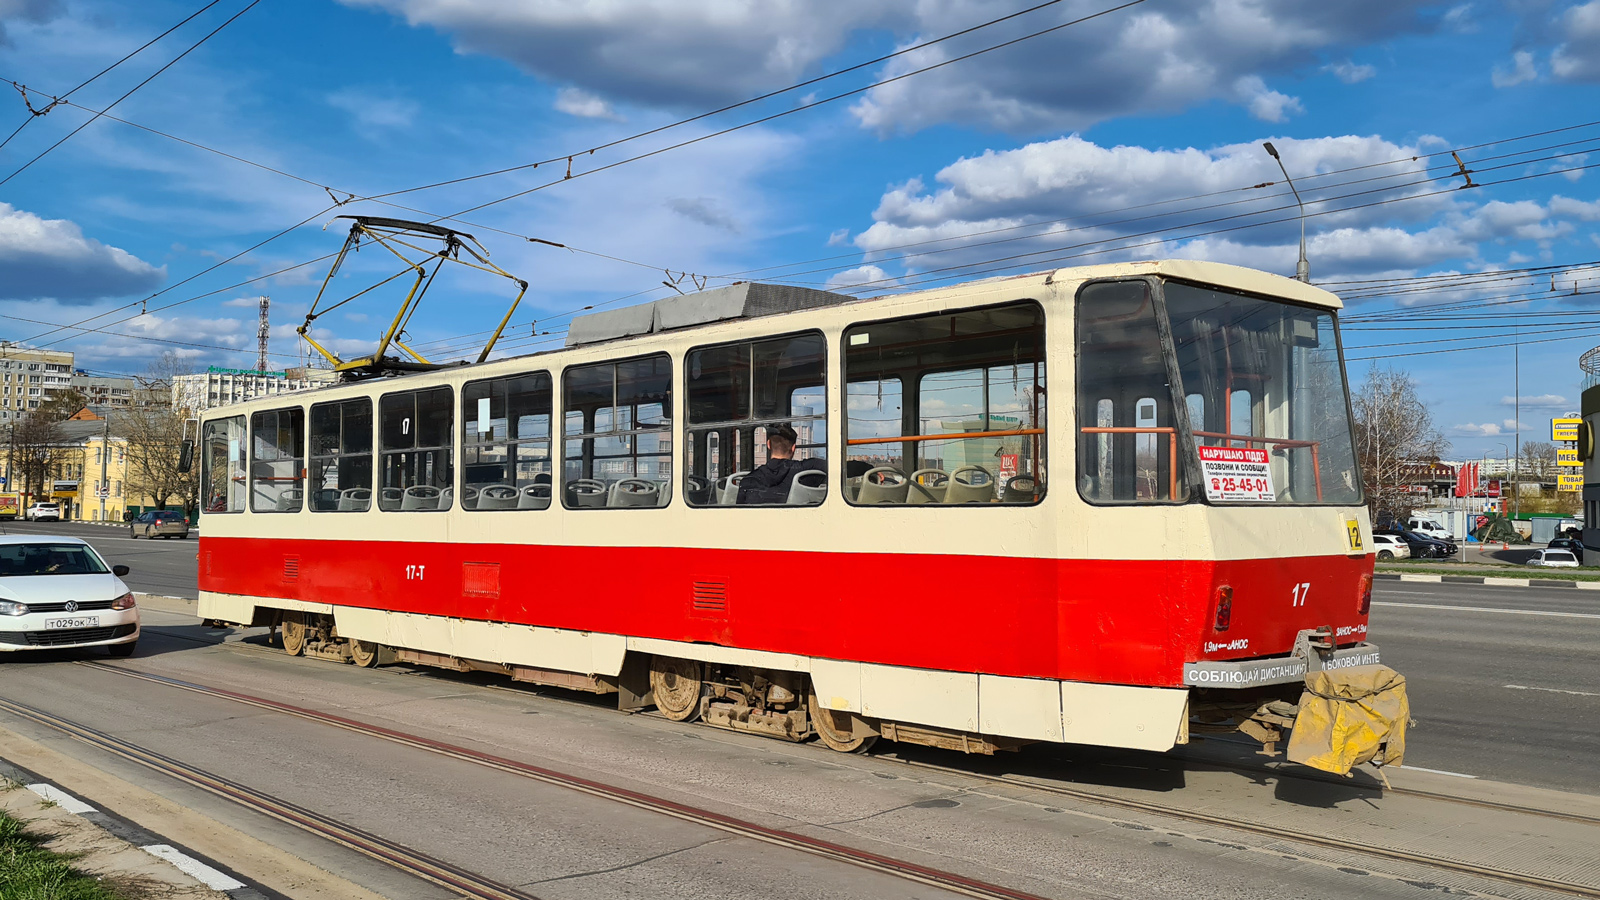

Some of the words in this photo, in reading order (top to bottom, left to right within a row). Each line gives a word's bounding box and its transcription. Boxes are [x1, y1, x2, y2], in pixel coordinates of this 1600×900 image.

[402, 417, 410, 435] 17
[1202, 448, 1244, 460] НАРУШАЮ
[1245, 450, 1265, 462] ПДД?
[1558, 453, 1578, 461] МЕБ
[1205, 463, 1234, 471] ПОЗВОНИ
[1241, 464, 1267, 473] СООБЩИ!
[1222, 477, 1268, 492] 25-45-01
[1347, 526, 1362, 548] 12
[1292, 582, 1310, 607] 17
[1336, 626, 1352, 636] ЗАНОС
[1188, 667, 1259, 684] СОБЛЮДАЙ
[1260, 663, 1306, 682] ДИСТАНЦИЮ
[1327, 653, 1361, 670] БОКОВОЙ
